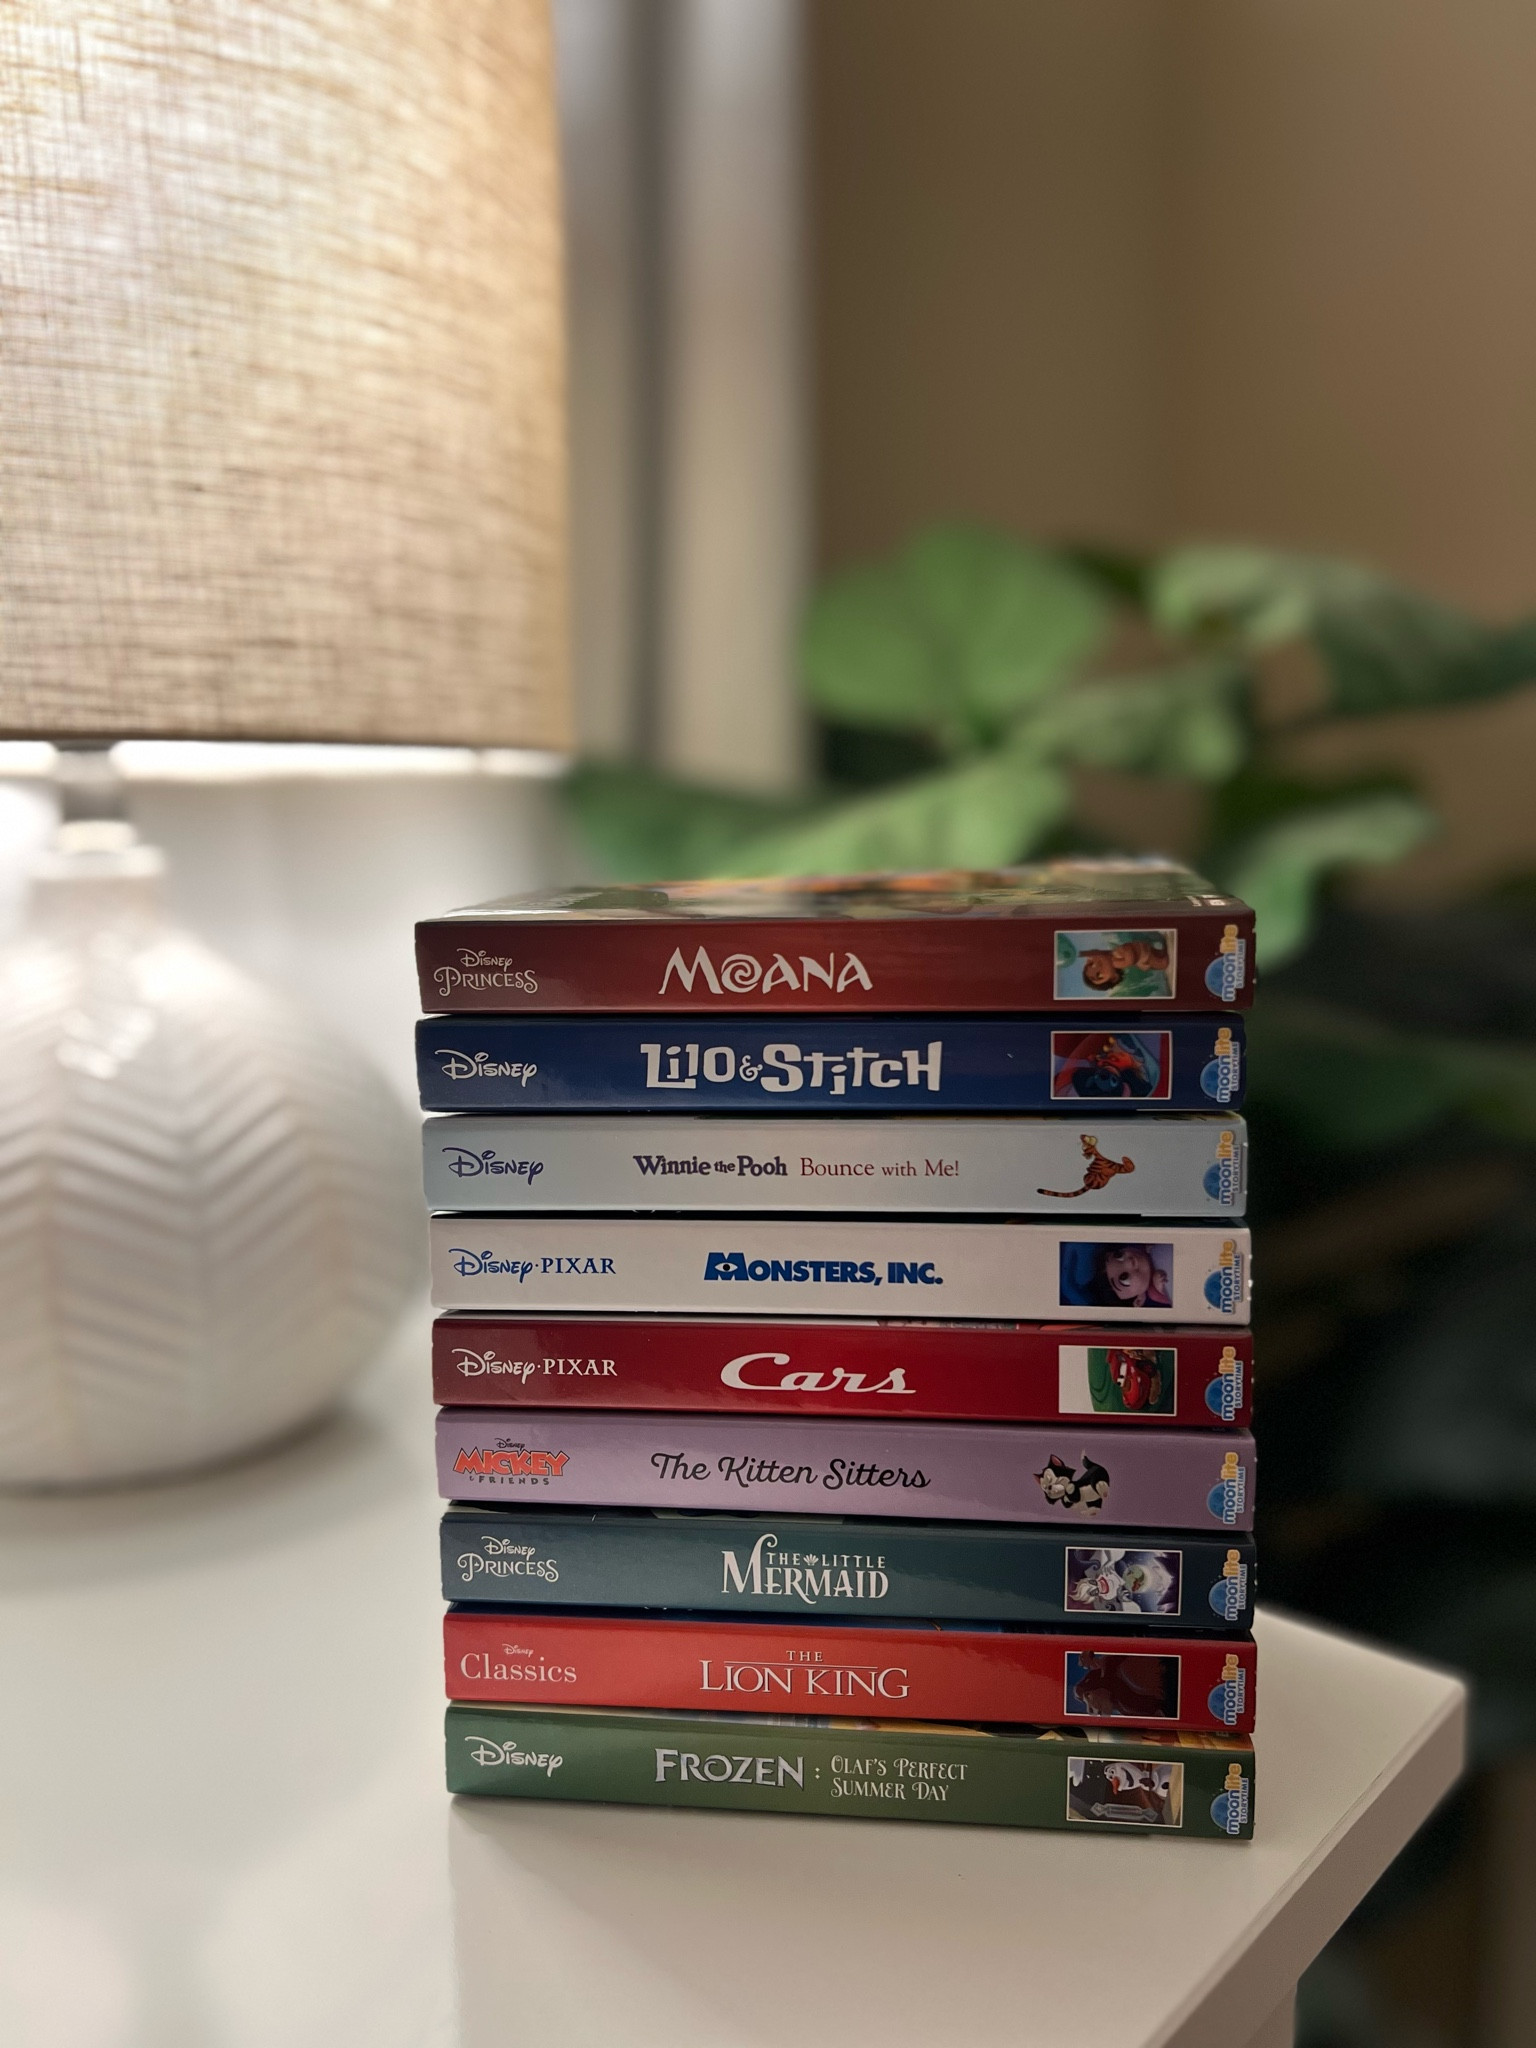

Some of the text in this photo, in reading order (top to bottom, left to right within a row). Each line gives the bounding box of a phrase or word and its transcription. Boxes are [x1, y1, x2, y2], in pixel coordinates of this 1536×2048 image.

[433, 966, 538, 997] PRINCESS
[658, 945, 873, 995] MOANA
[1221, 924, 1239, 1002] moonlite
[739, 1055, 762, 1082] &
[1215, 1027, 1233, 1103] moonlite
[633, 1155, 788, 1177] Winnie the Pooh
[800, 1157, 959, 1177] Bounce with Me!
[1217, 1131, 1235, 1206] moonlite
[703, 1252, 944, 1286] MONSTERS, INC.
[1219, 1240, 1234, 1315] moonlite
[720, 1352, 917, 1394] Cars
[1219, 1346, 1236, 1421] moonlite
[453, 1447, 570, 1477] MICKEY
[479, 1475, 550, 1485] FRIENDS
[651, 1452, 931, 1490] The Kitten Sitters
[1221, 1452, 1238, 1524] moonlite
[457, 1552, 559, 1582] PRINCESS
[721, 1533, 889, 1604] MERMAID
[767, 1552, 886, 1569] THE LITTLE
[1223, 1549, 1240, 1620] moonlite
[460, 1653, 577, 1683] Classics
[786, 1650, 823, 1662] THE
[700, 1660, 910, 1699] LION KING
[1222, 1654, 1239, 1725] moonlite
[654, 1748, 804, 1790] FROZEN
[830, 1755, 968, 1780] OLAF'S PERFECT
[830, 1777, 949, 1801] SUMMER DAY
[1226, 1764, 1242, 1834] moonlite
